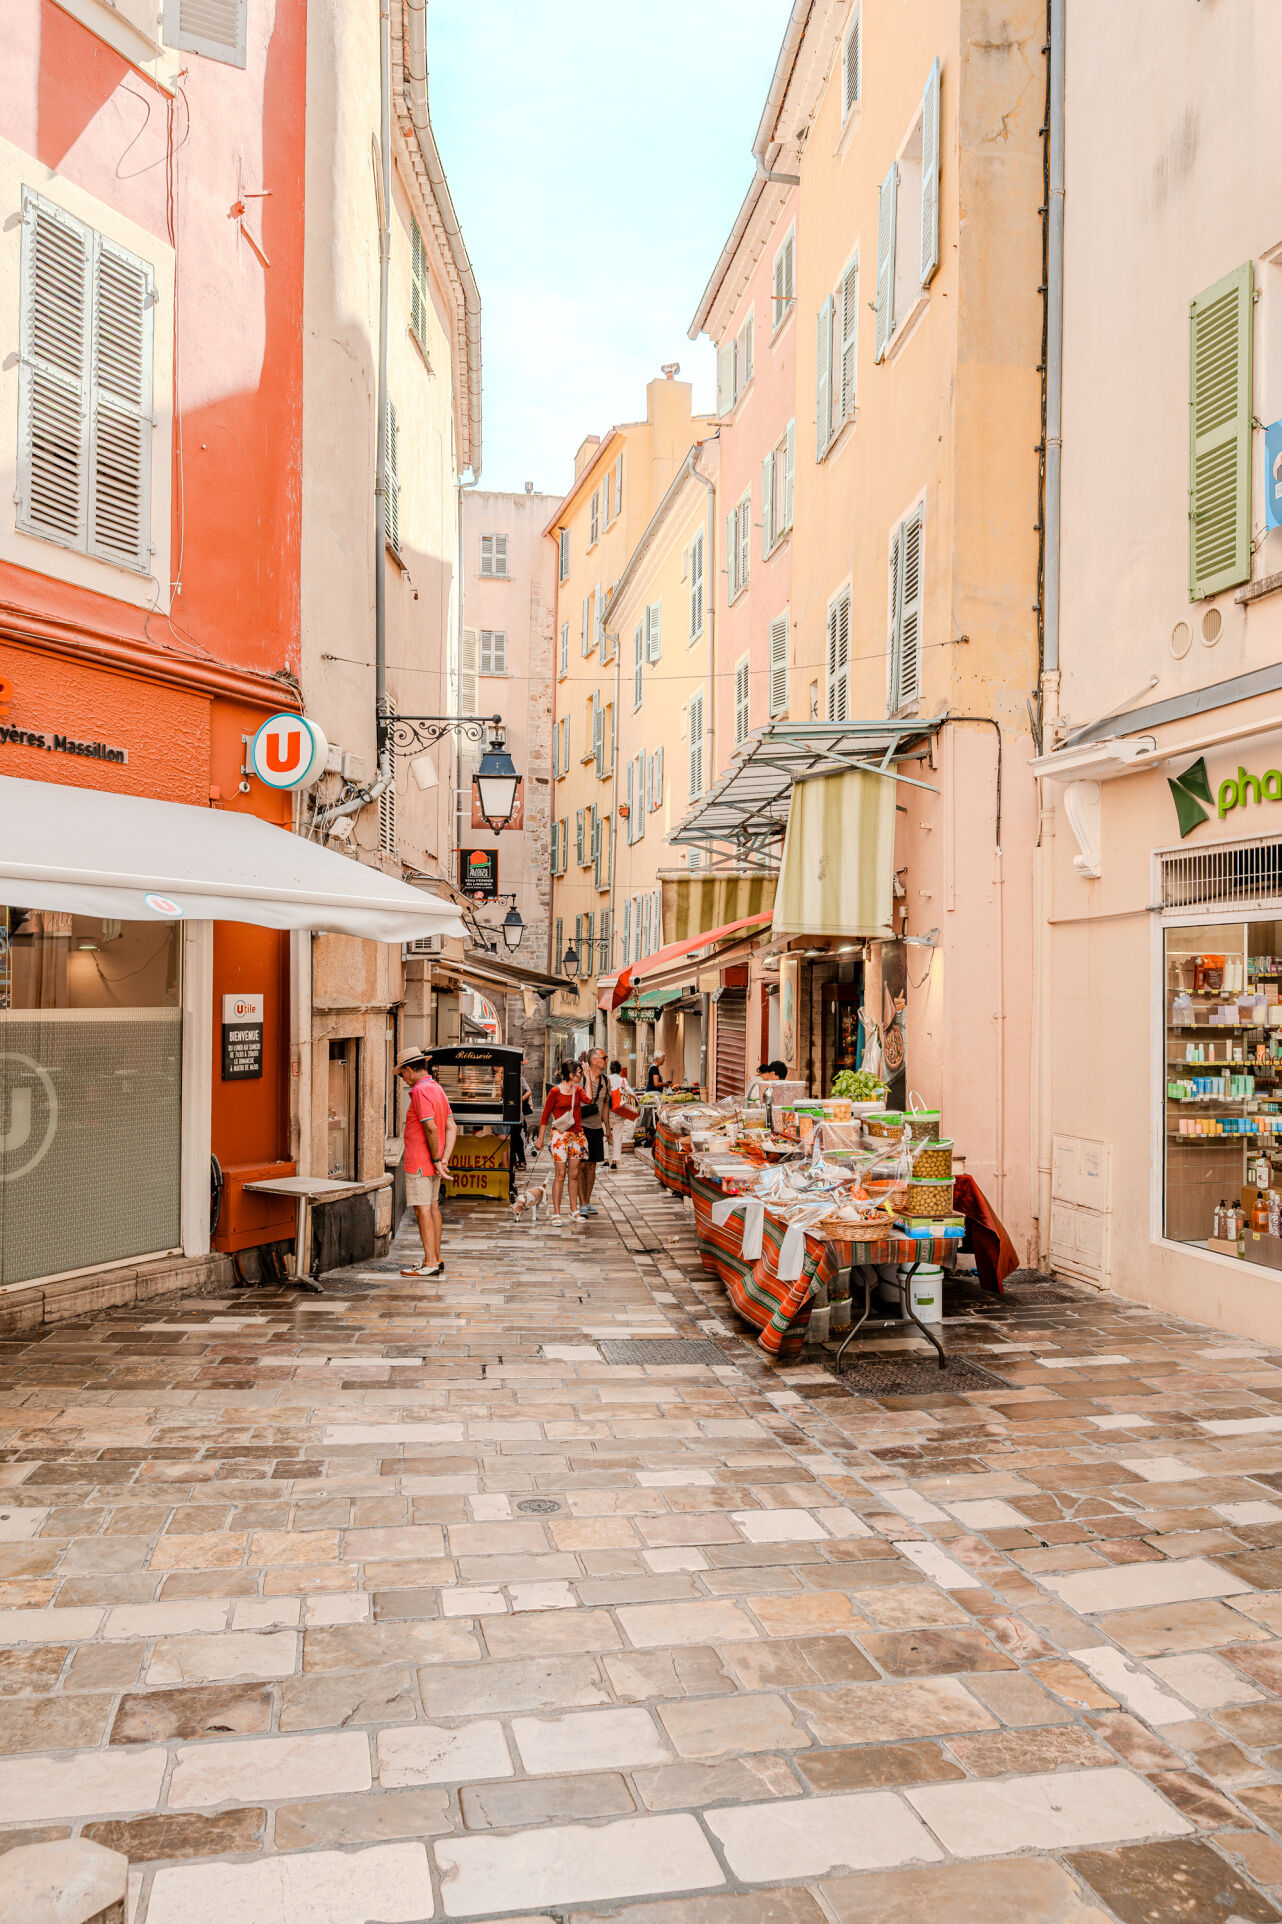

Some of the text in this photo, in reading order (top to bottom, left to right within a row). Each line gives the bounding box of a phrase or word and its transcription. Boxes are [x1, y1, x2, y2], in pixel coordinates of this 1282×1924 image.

[53, 734, 125, 763] Massillon
[266, 731, 301, 772] U
[151, 900, 177, 912] U
[237, 1004, 256, 1014] Utile
[229, 1030, 260, 1041] BIENVENUE
[448, 1155, 496, 1169] OULETS
[452, 1174, 488, 1189] ROTIS
